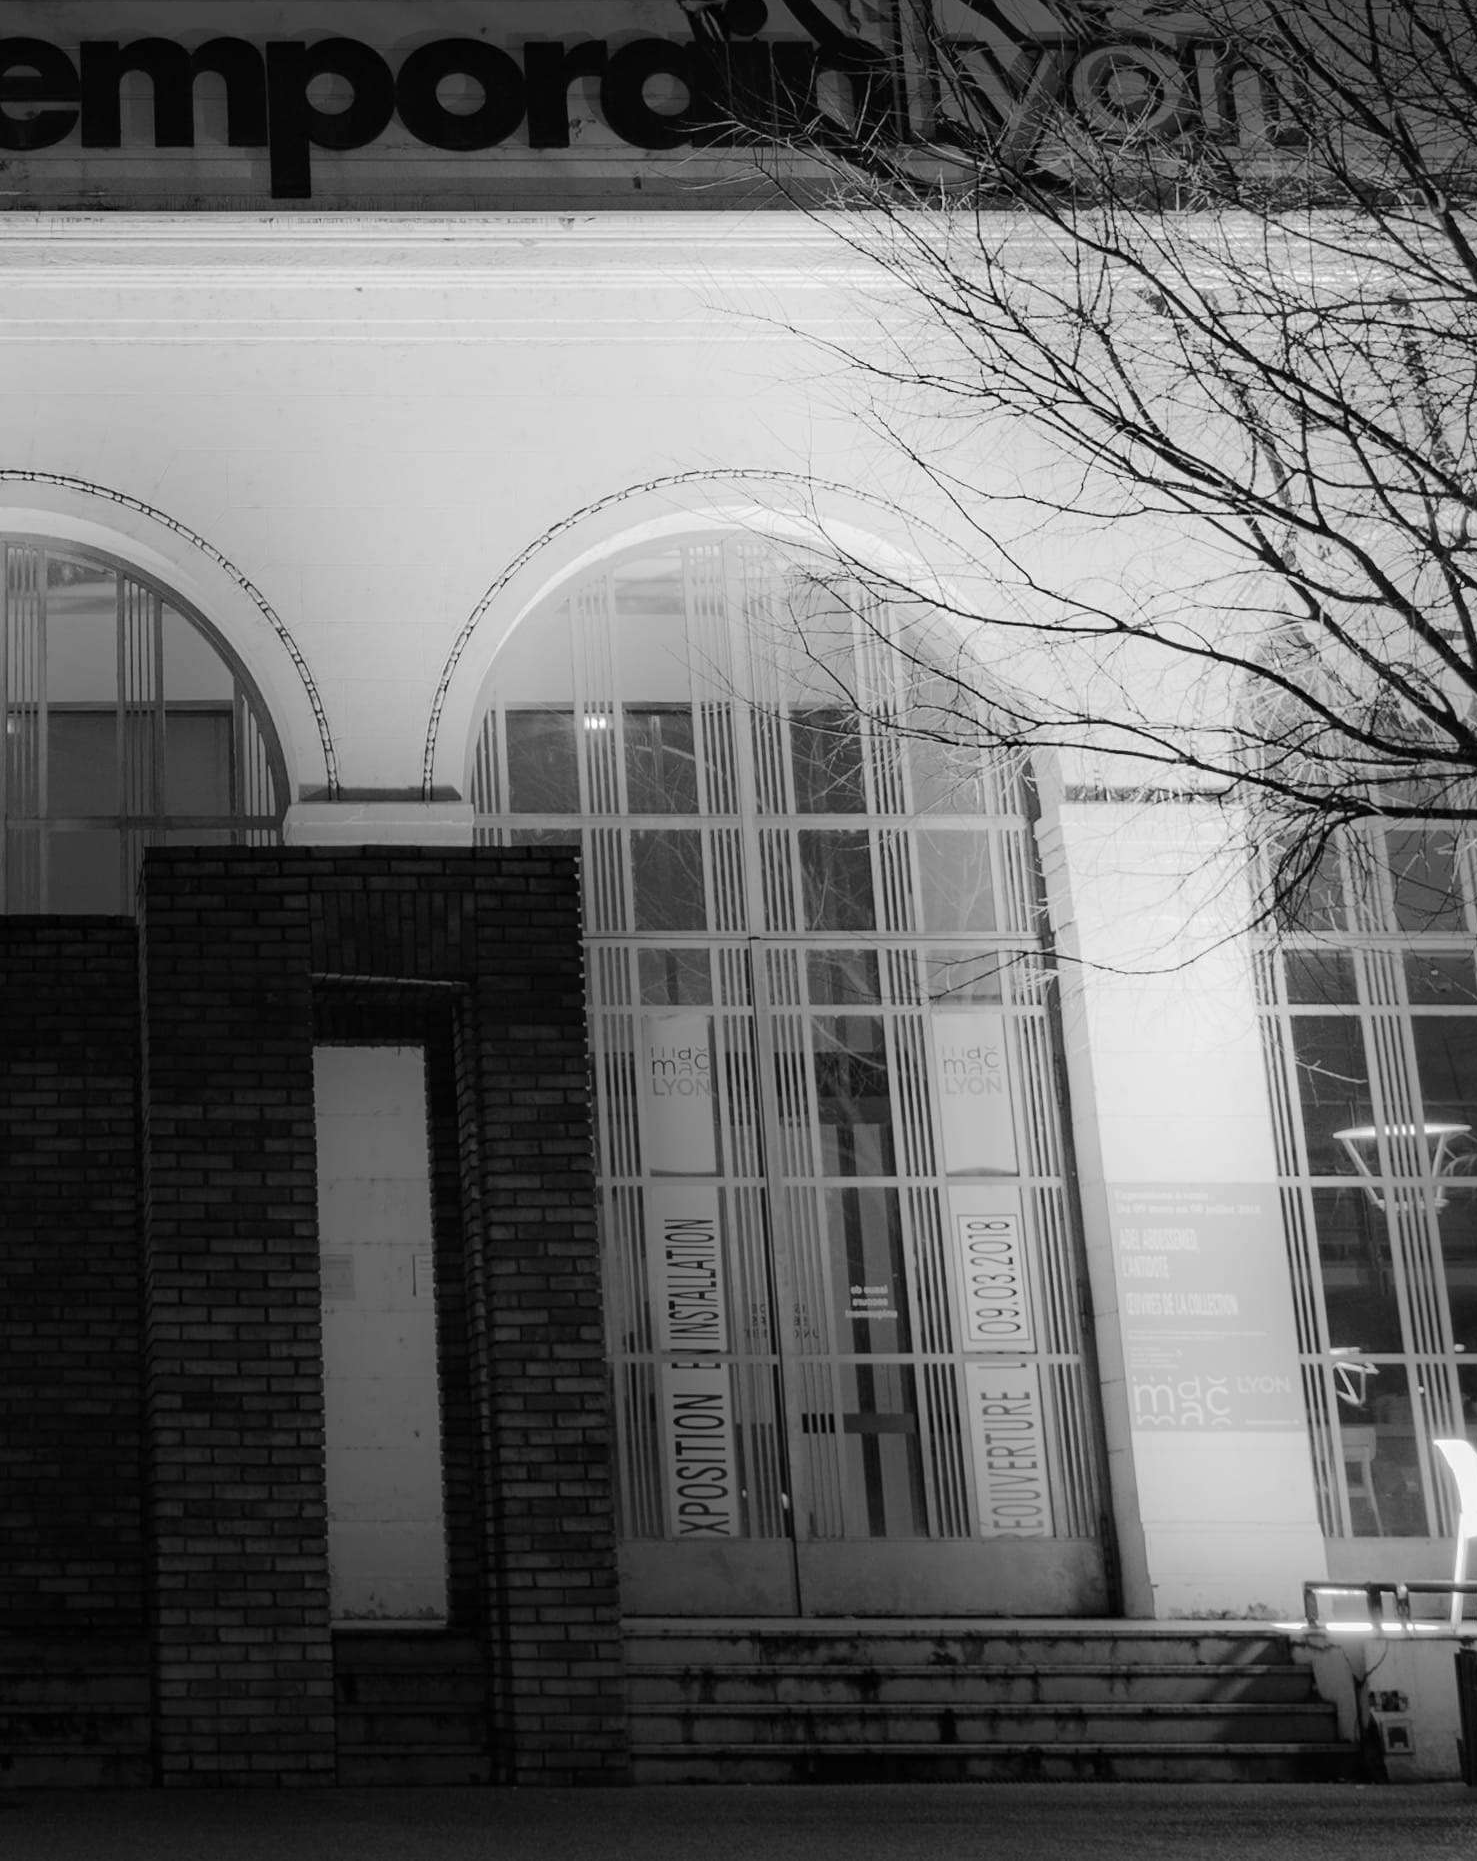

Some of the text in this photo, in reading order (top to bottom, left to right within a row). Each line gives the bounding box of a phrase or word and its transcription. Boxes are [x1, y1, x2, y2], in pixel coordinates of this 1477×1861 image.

[652, 1078, 712, 1096] LYON
[944, 1076, 1003, 1096] LYON
[664, 1219, 720, 1340] INSTALLATION
[966, 1220, 1022, 1334] 09.03.2018
[1234, 1376, 1292, 1394] LYON
